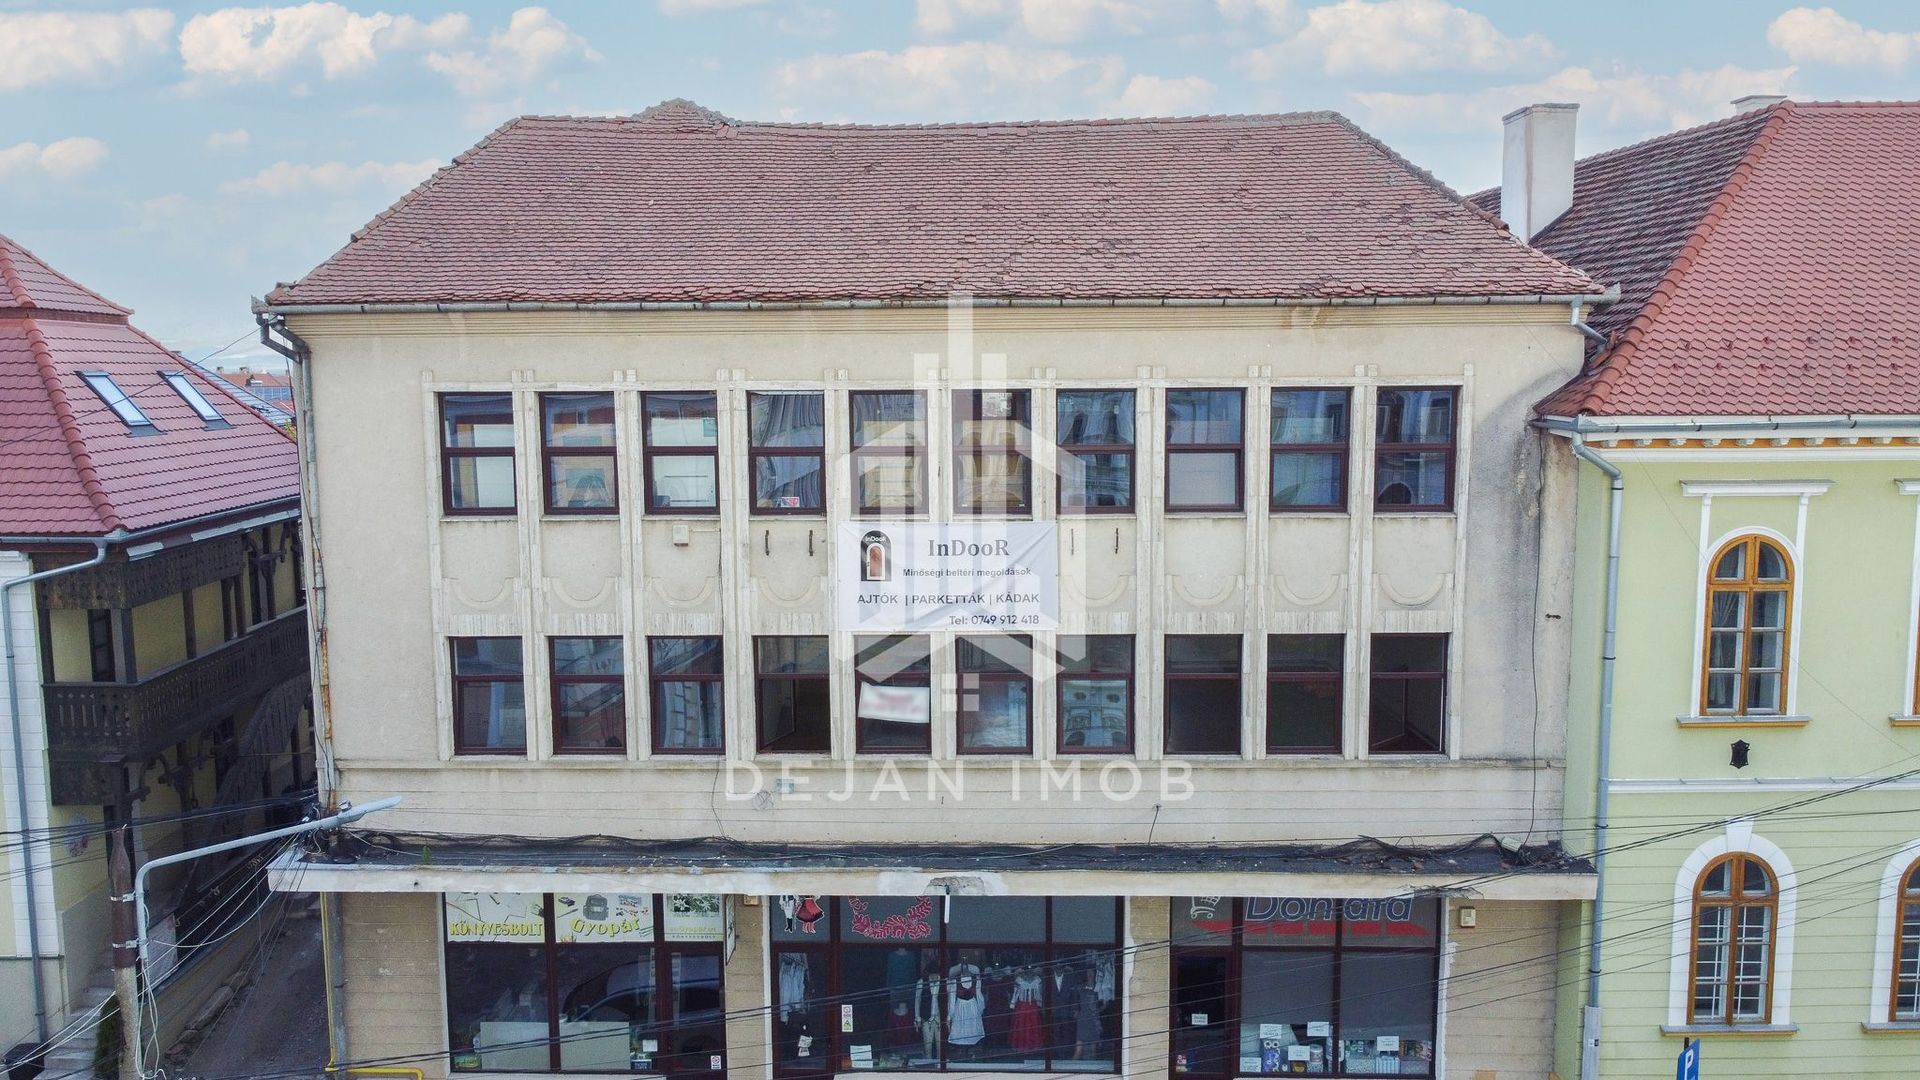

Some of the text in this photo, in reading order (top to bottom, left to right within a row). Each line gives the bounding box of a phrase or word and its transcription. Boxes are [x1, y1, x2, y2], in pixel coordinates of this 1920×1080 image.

[928, 539, 1010, 557] InDooR
[902, 567, 1031, 578] Minőségi beltéri megoldások
[857, 591, 1040, 604] AJTÓK PARKETTÁK KÁDAK
[949, 614, 1039, 625] Tel: 0749 912 418
[450, 921, 543, 937] KÖNYVESBOLT
[569, 917, 641, 938] Gyopár
[1684, 1049, 1694, 1080] P
